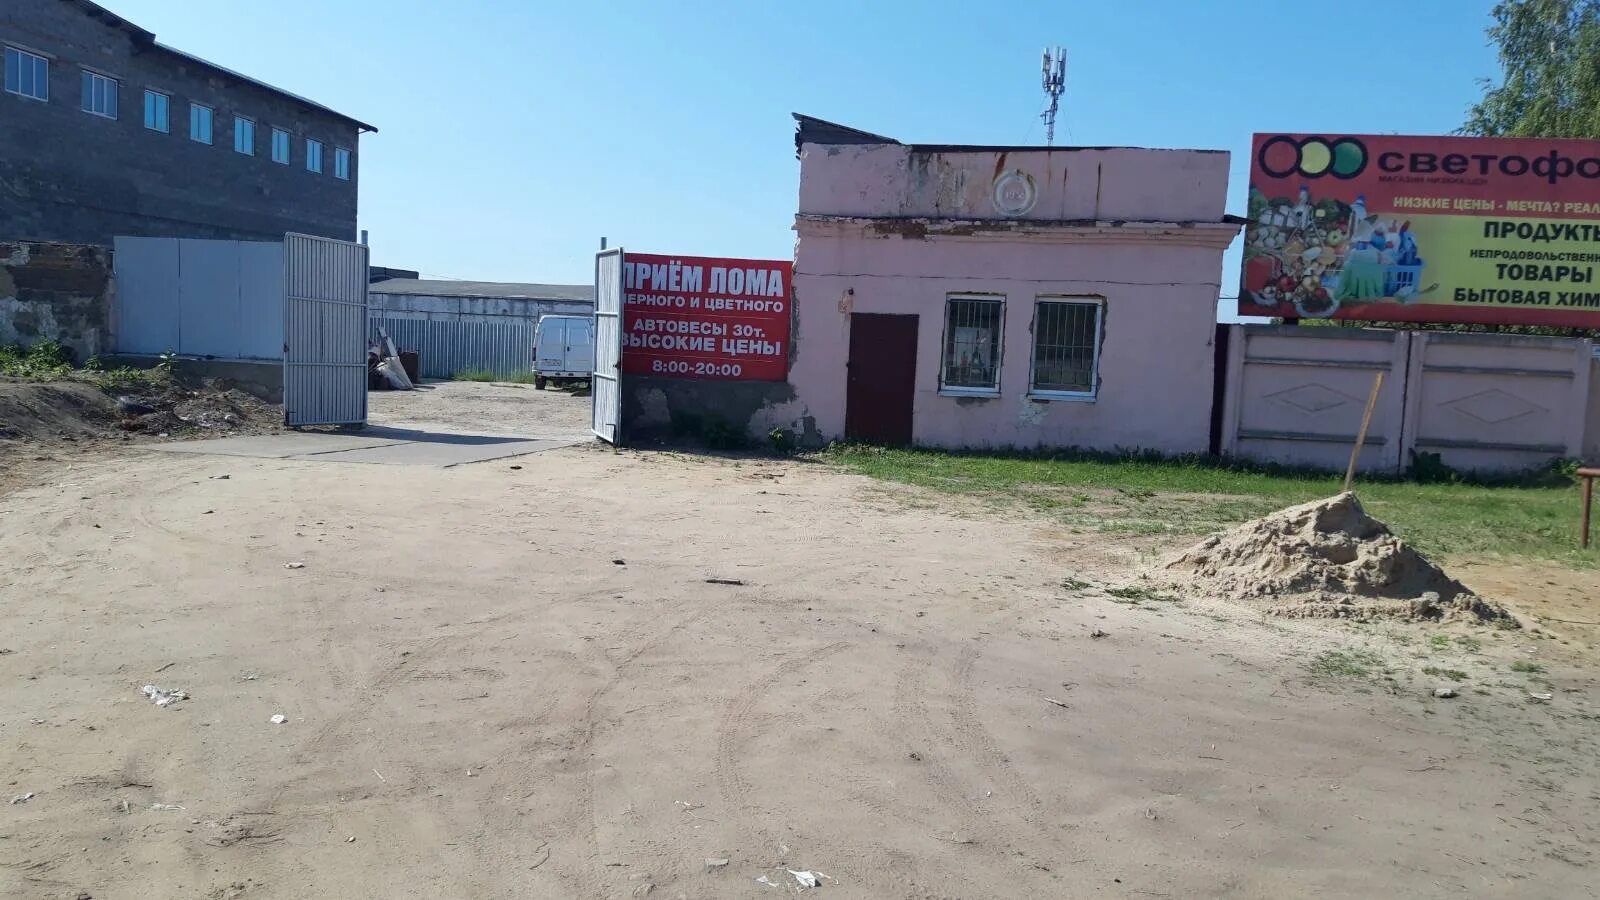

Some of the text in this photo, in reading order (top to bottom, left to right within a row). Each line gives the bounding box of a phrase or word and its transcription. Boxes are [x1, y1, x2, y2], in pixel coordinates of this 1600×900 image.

[1392, 197, 1450, 209] НИЗКИЕ
[1453, 198, 1495, 211] ЦЕНЫ
[1506, 200, 1560, 213] МЕЧТА?
[623, 260, 784, 297] ПРИЁМ ЛОМА
[1496, 263, 1593, 283] ТОВАРЫ
[690, 298, 700, 309] И
[704, 298, 784, 313] ЦВЕТНОГО
[1453, 287, 1551, 306] БЫТОВАЯ
[633, 318, 766, 338] АВТОВЕСЫ 30т.
[721, 338, 781, 356] ЦЕНЫ
[652, 359, 742, 377] 8:00-20:00
